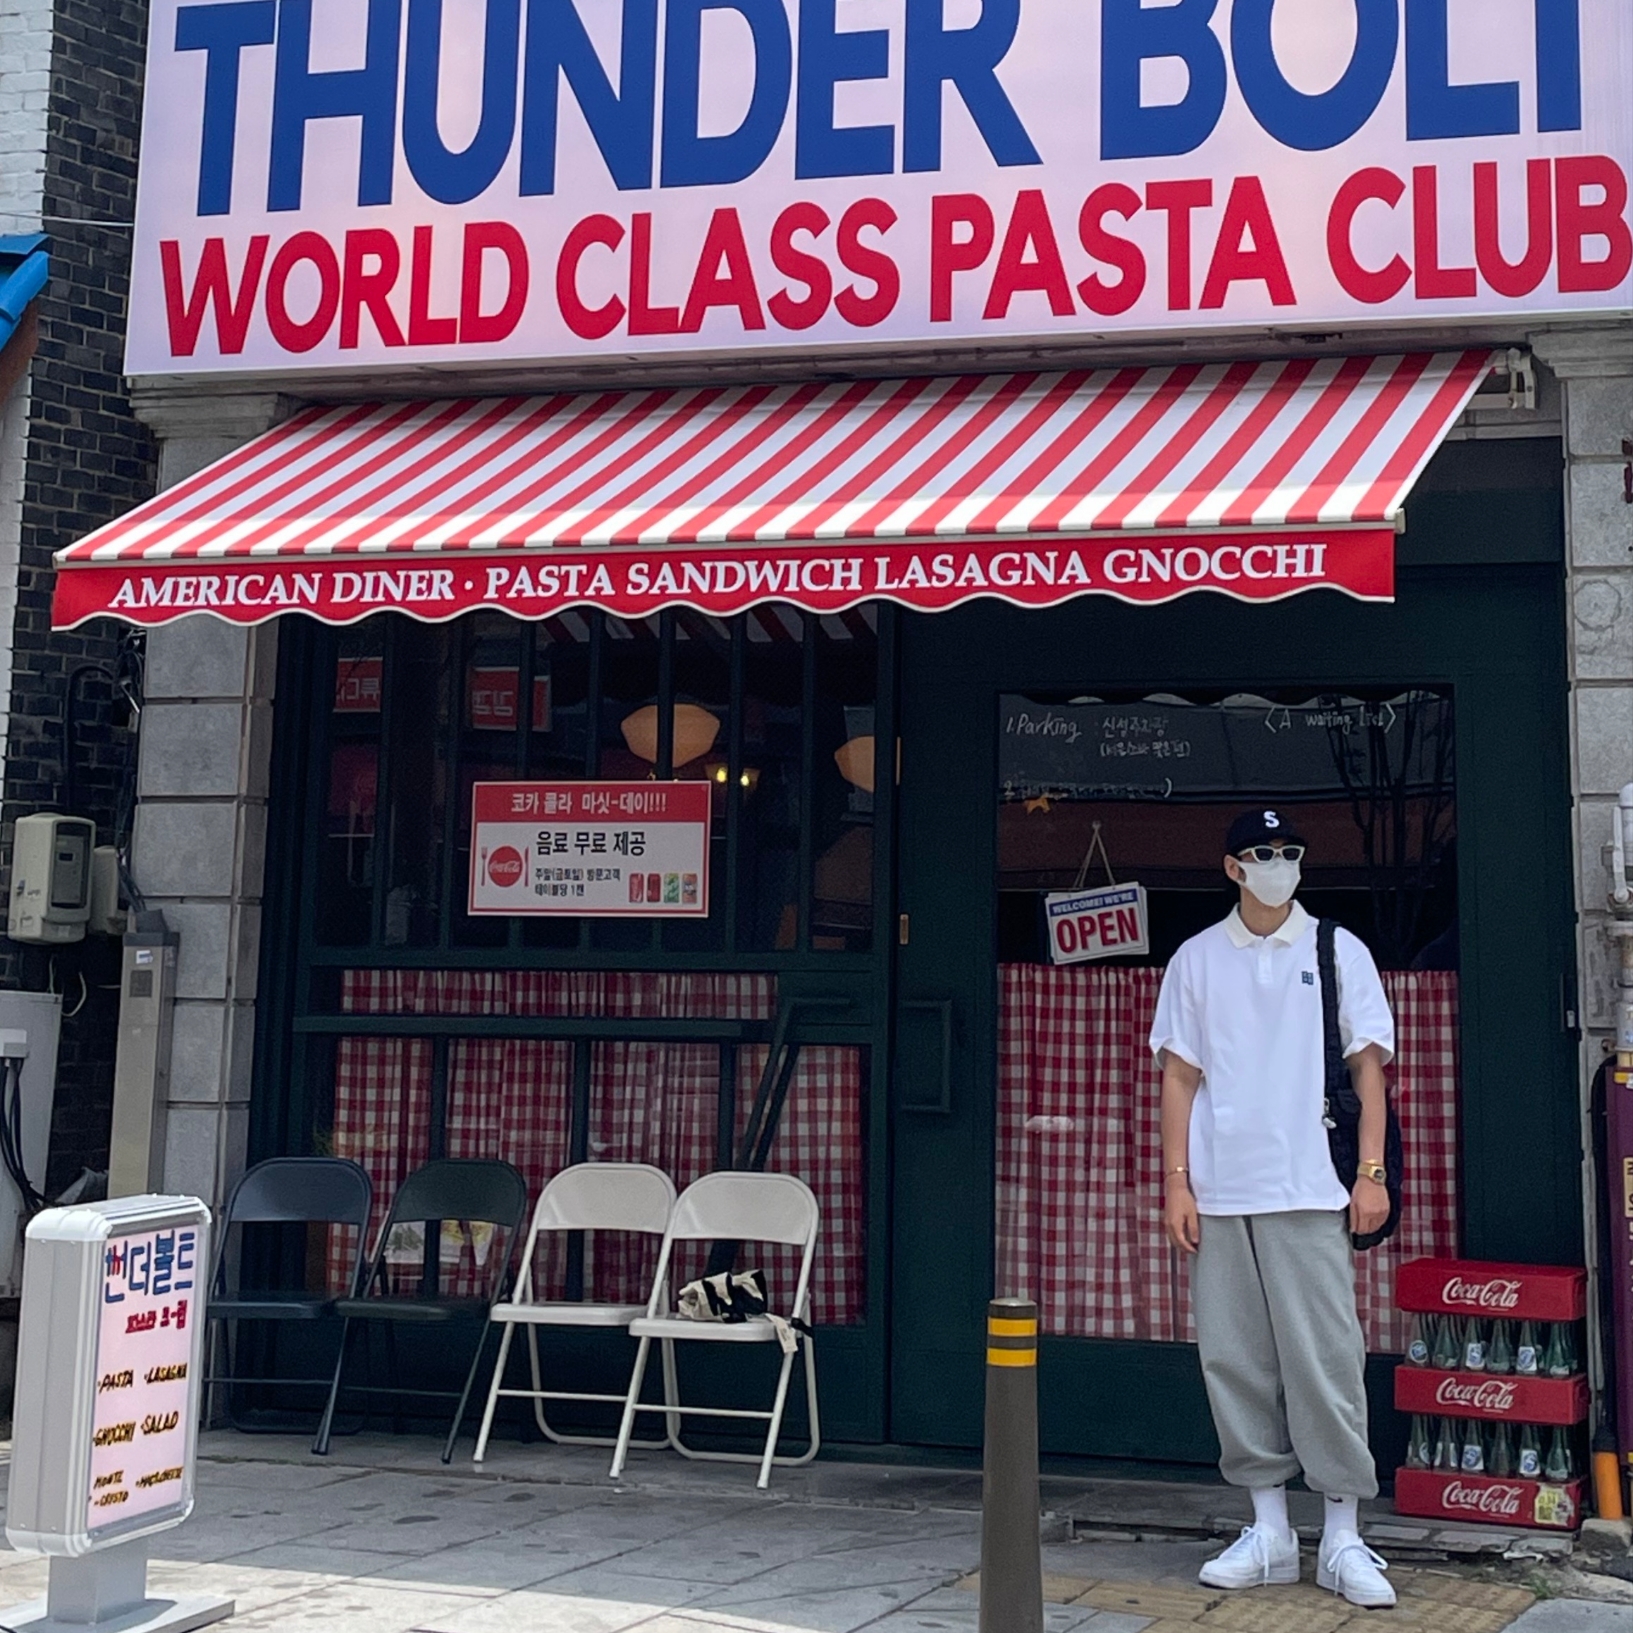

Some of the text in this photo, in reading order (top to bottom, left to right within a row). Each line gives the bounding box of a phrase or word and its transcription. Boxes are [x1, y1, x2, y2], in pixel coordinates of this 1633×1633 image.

[173, 0, 1043, 217] THUNDER
[160, 154, 1632, 357] WORLD CLASS PASTA CLUB
[108, 543, 1328, 608] AMERICAN DINER PASTA SANDWICH LASAGNA GNOCCHI
[511, 791, 539, 815] 코카
[1263, 810, 1280, 828] S
[535, 830, 646, 856] 음료 무료 제공
[1056, 907, 1139, 954] OPEN
[143, 1410, 179, 1436] SALAD
